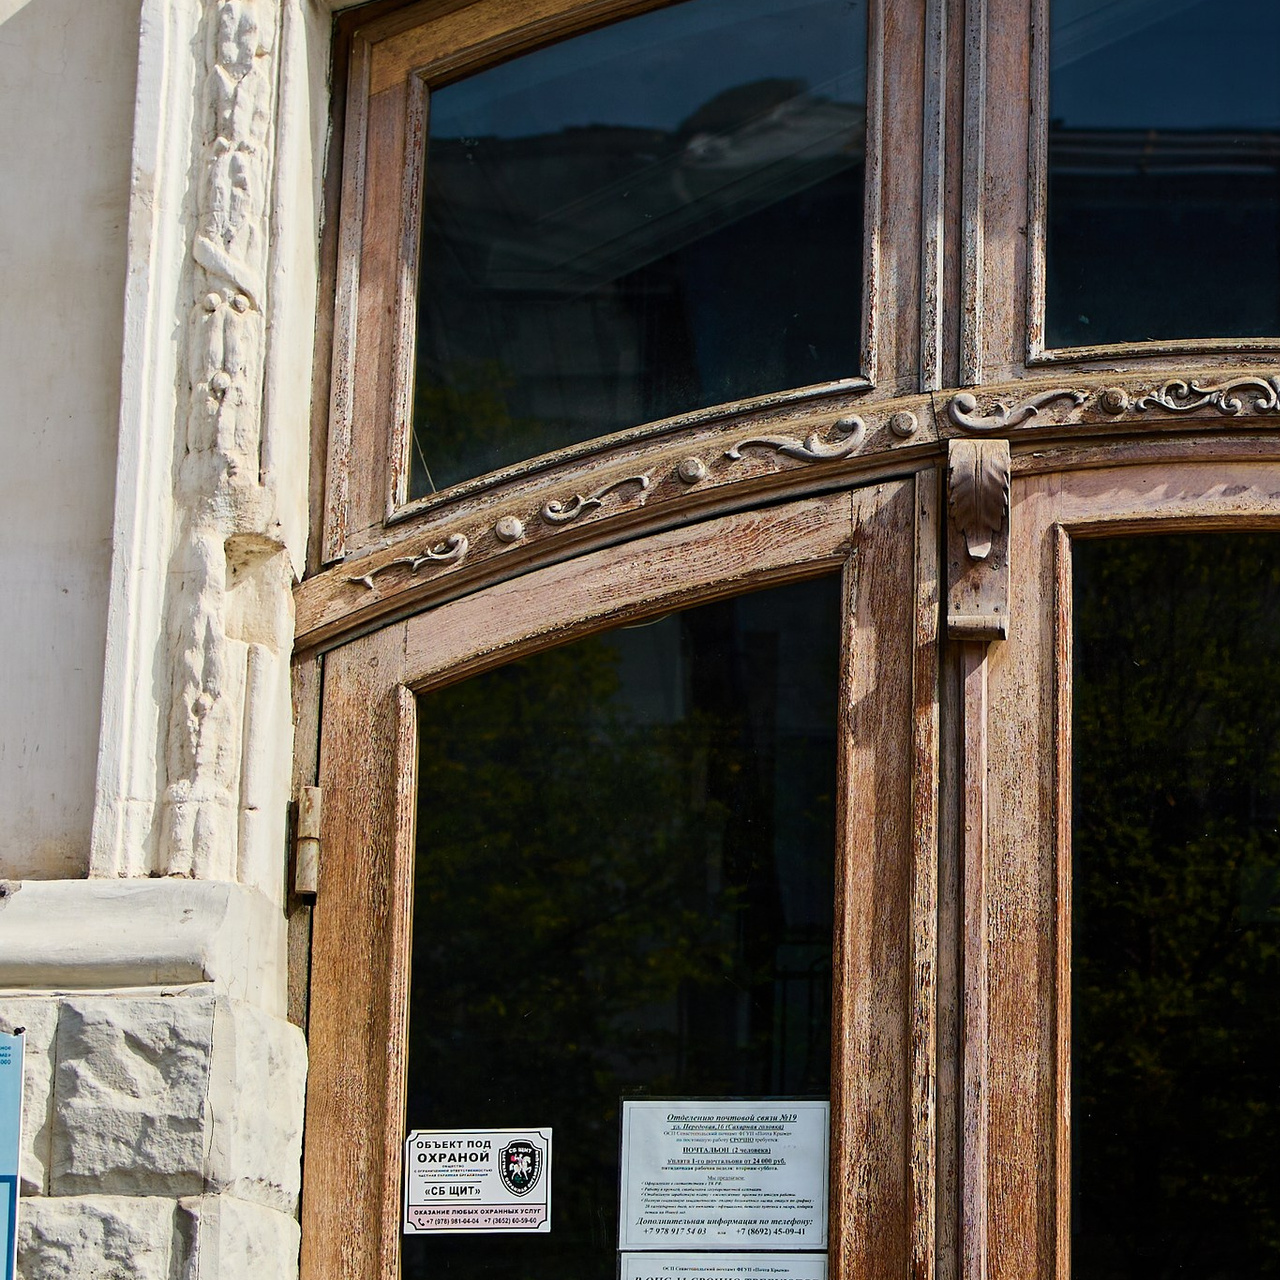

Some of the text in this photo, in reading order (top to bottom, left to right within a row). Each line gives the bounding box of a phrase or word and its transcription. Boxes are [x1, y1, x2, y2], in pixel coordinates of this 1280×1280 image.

[667, 1114, 797, 1122] Отделению почтовой связи №19
[416, 1141, 492, 1149] ОБЪЕКТ ПОД
[417, 1151, 489, 1163] ОХРАНОЙ
[425, 1186, 481, 1197] «СБ ЩИТ»
[635, 1217, 705, 1225] Дополнительная
[706, 1218, 757, 1226] информация
[771, 1218, 813, 1226] телефону:
[747, 1228, 772, 1236] (8692)
